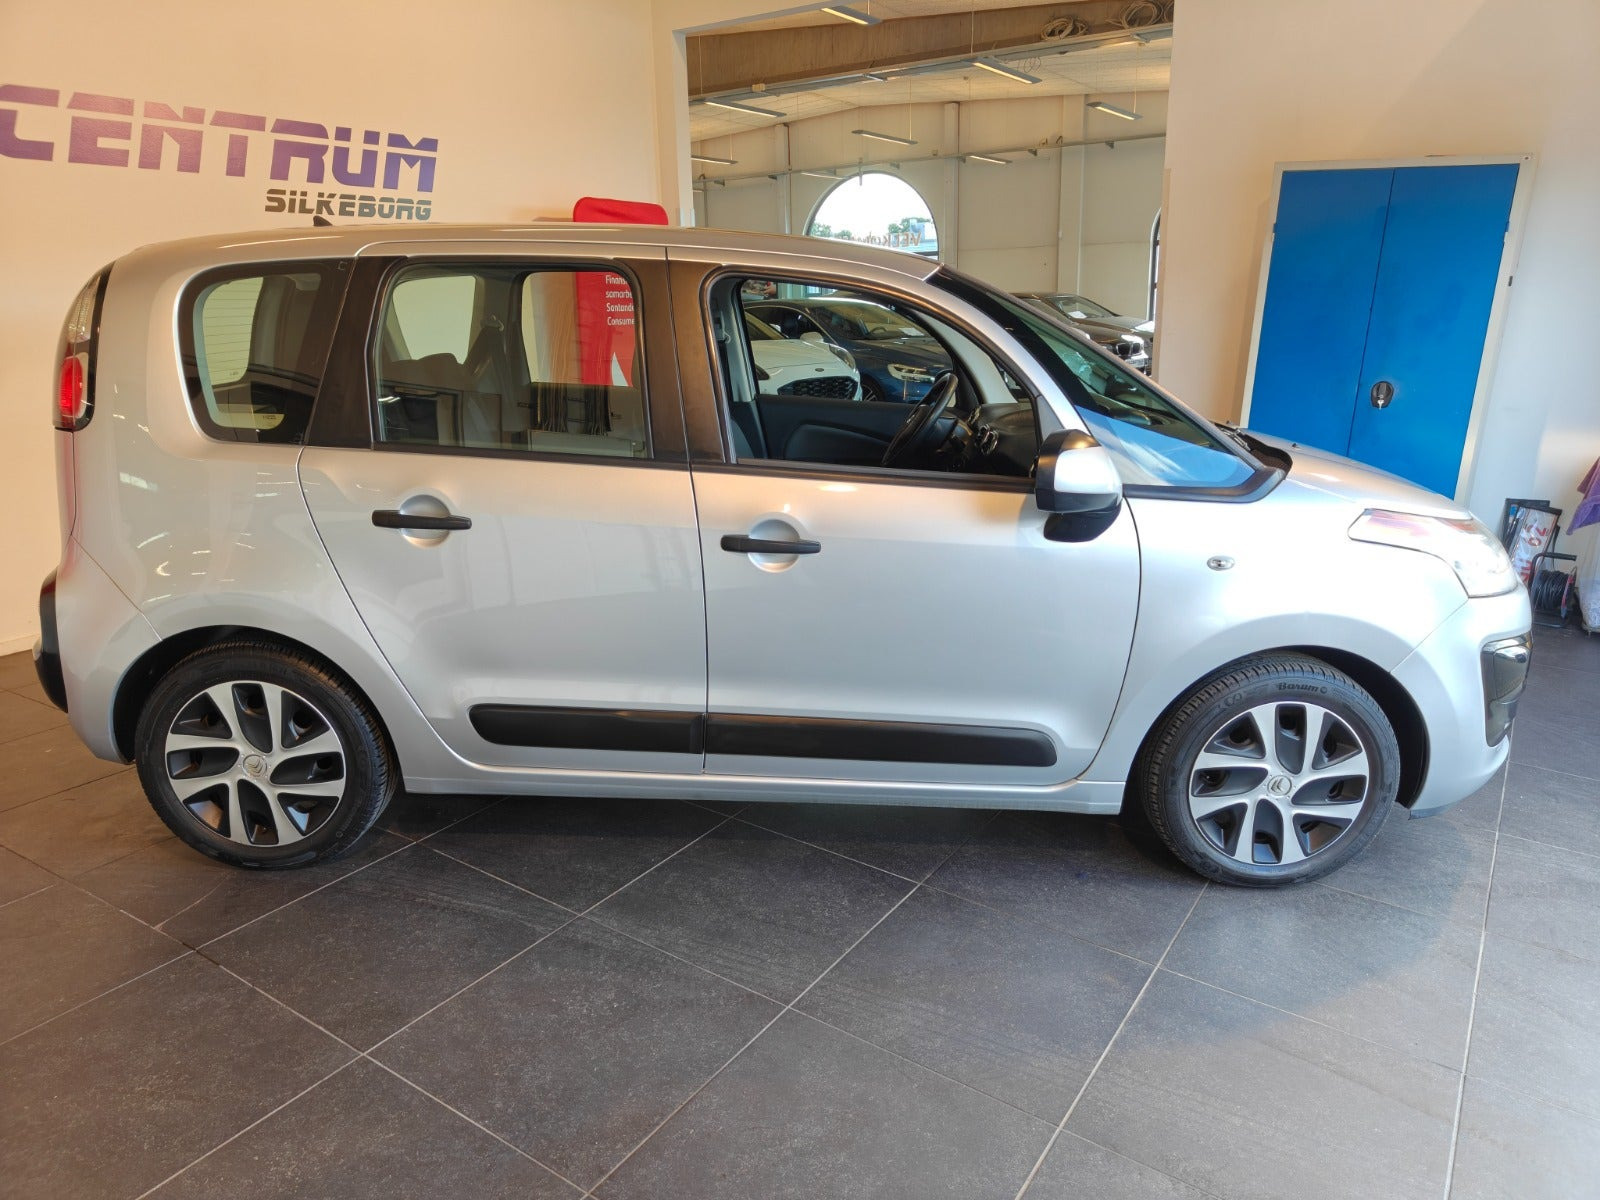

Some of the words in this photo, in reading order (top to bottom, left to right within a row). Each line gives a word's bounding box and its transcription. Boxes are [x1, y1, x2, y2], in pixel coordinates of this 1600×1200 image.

[0, 83, 439, 193] CENTRUM
[605, 274, 628, 285] Finans
[1277, 682, 1319, 693] Barum
